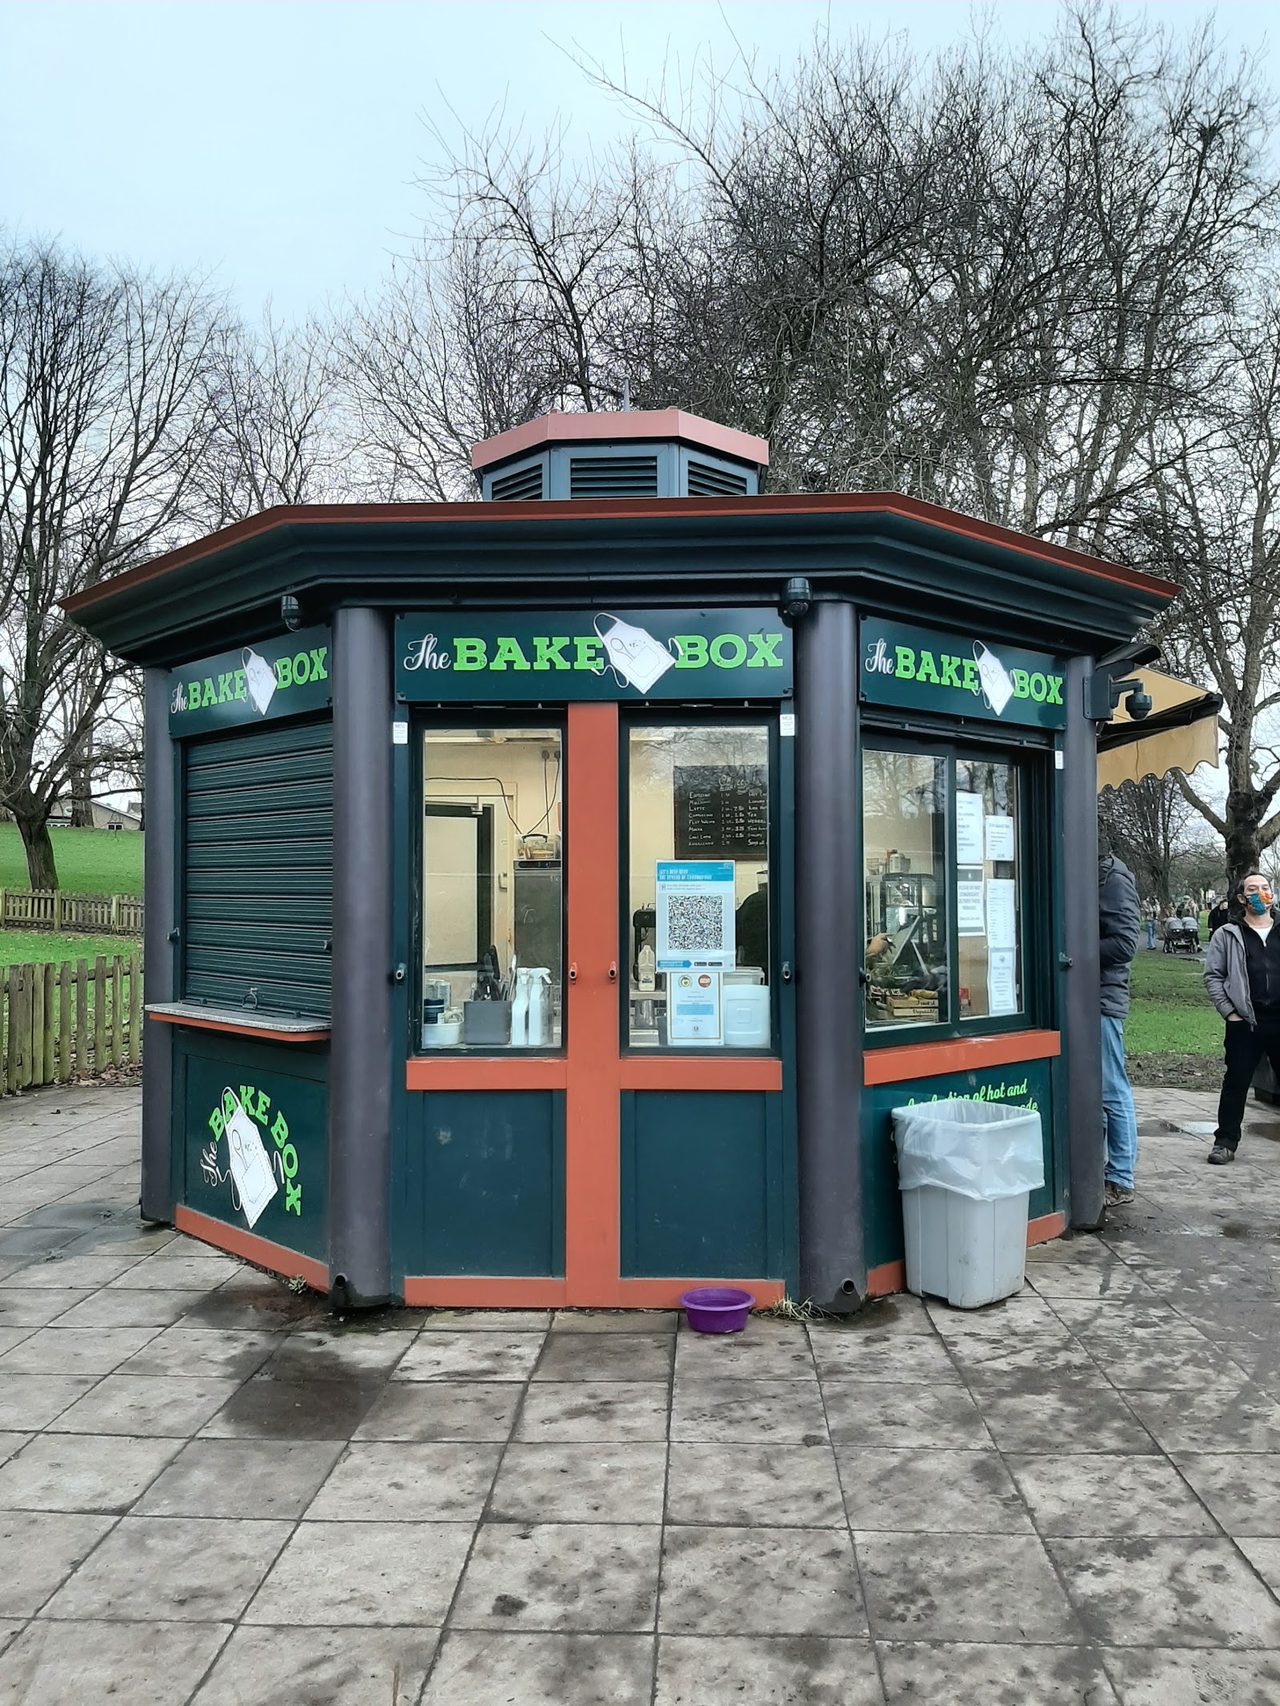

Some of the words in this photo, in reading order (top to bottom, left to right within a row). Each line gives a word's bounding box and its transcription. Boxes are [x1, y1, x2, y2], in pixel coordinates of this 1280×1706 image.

[170, 681, 189, 714] The
[187, 668, 248, 711] BAKE
[275, 646, 328, 690] BOX
[403, 633, 451, 671] The
[453, 636, 605, 671] BAKE
[674, 633, 784, 669] BOX
[865, 637, 895, 675] The
[894, 645, 980, 691] BAKE
[1012, 668, 1064, 705] BOX
[208, 1085, 271, 1142] BAKE
[986, 1081, 1006, 1101] hot
[1006, 1077, 1028, 1098] and
[200, 1140, 218, 1187] The
[270, 1110, 303, 1217] BOX
